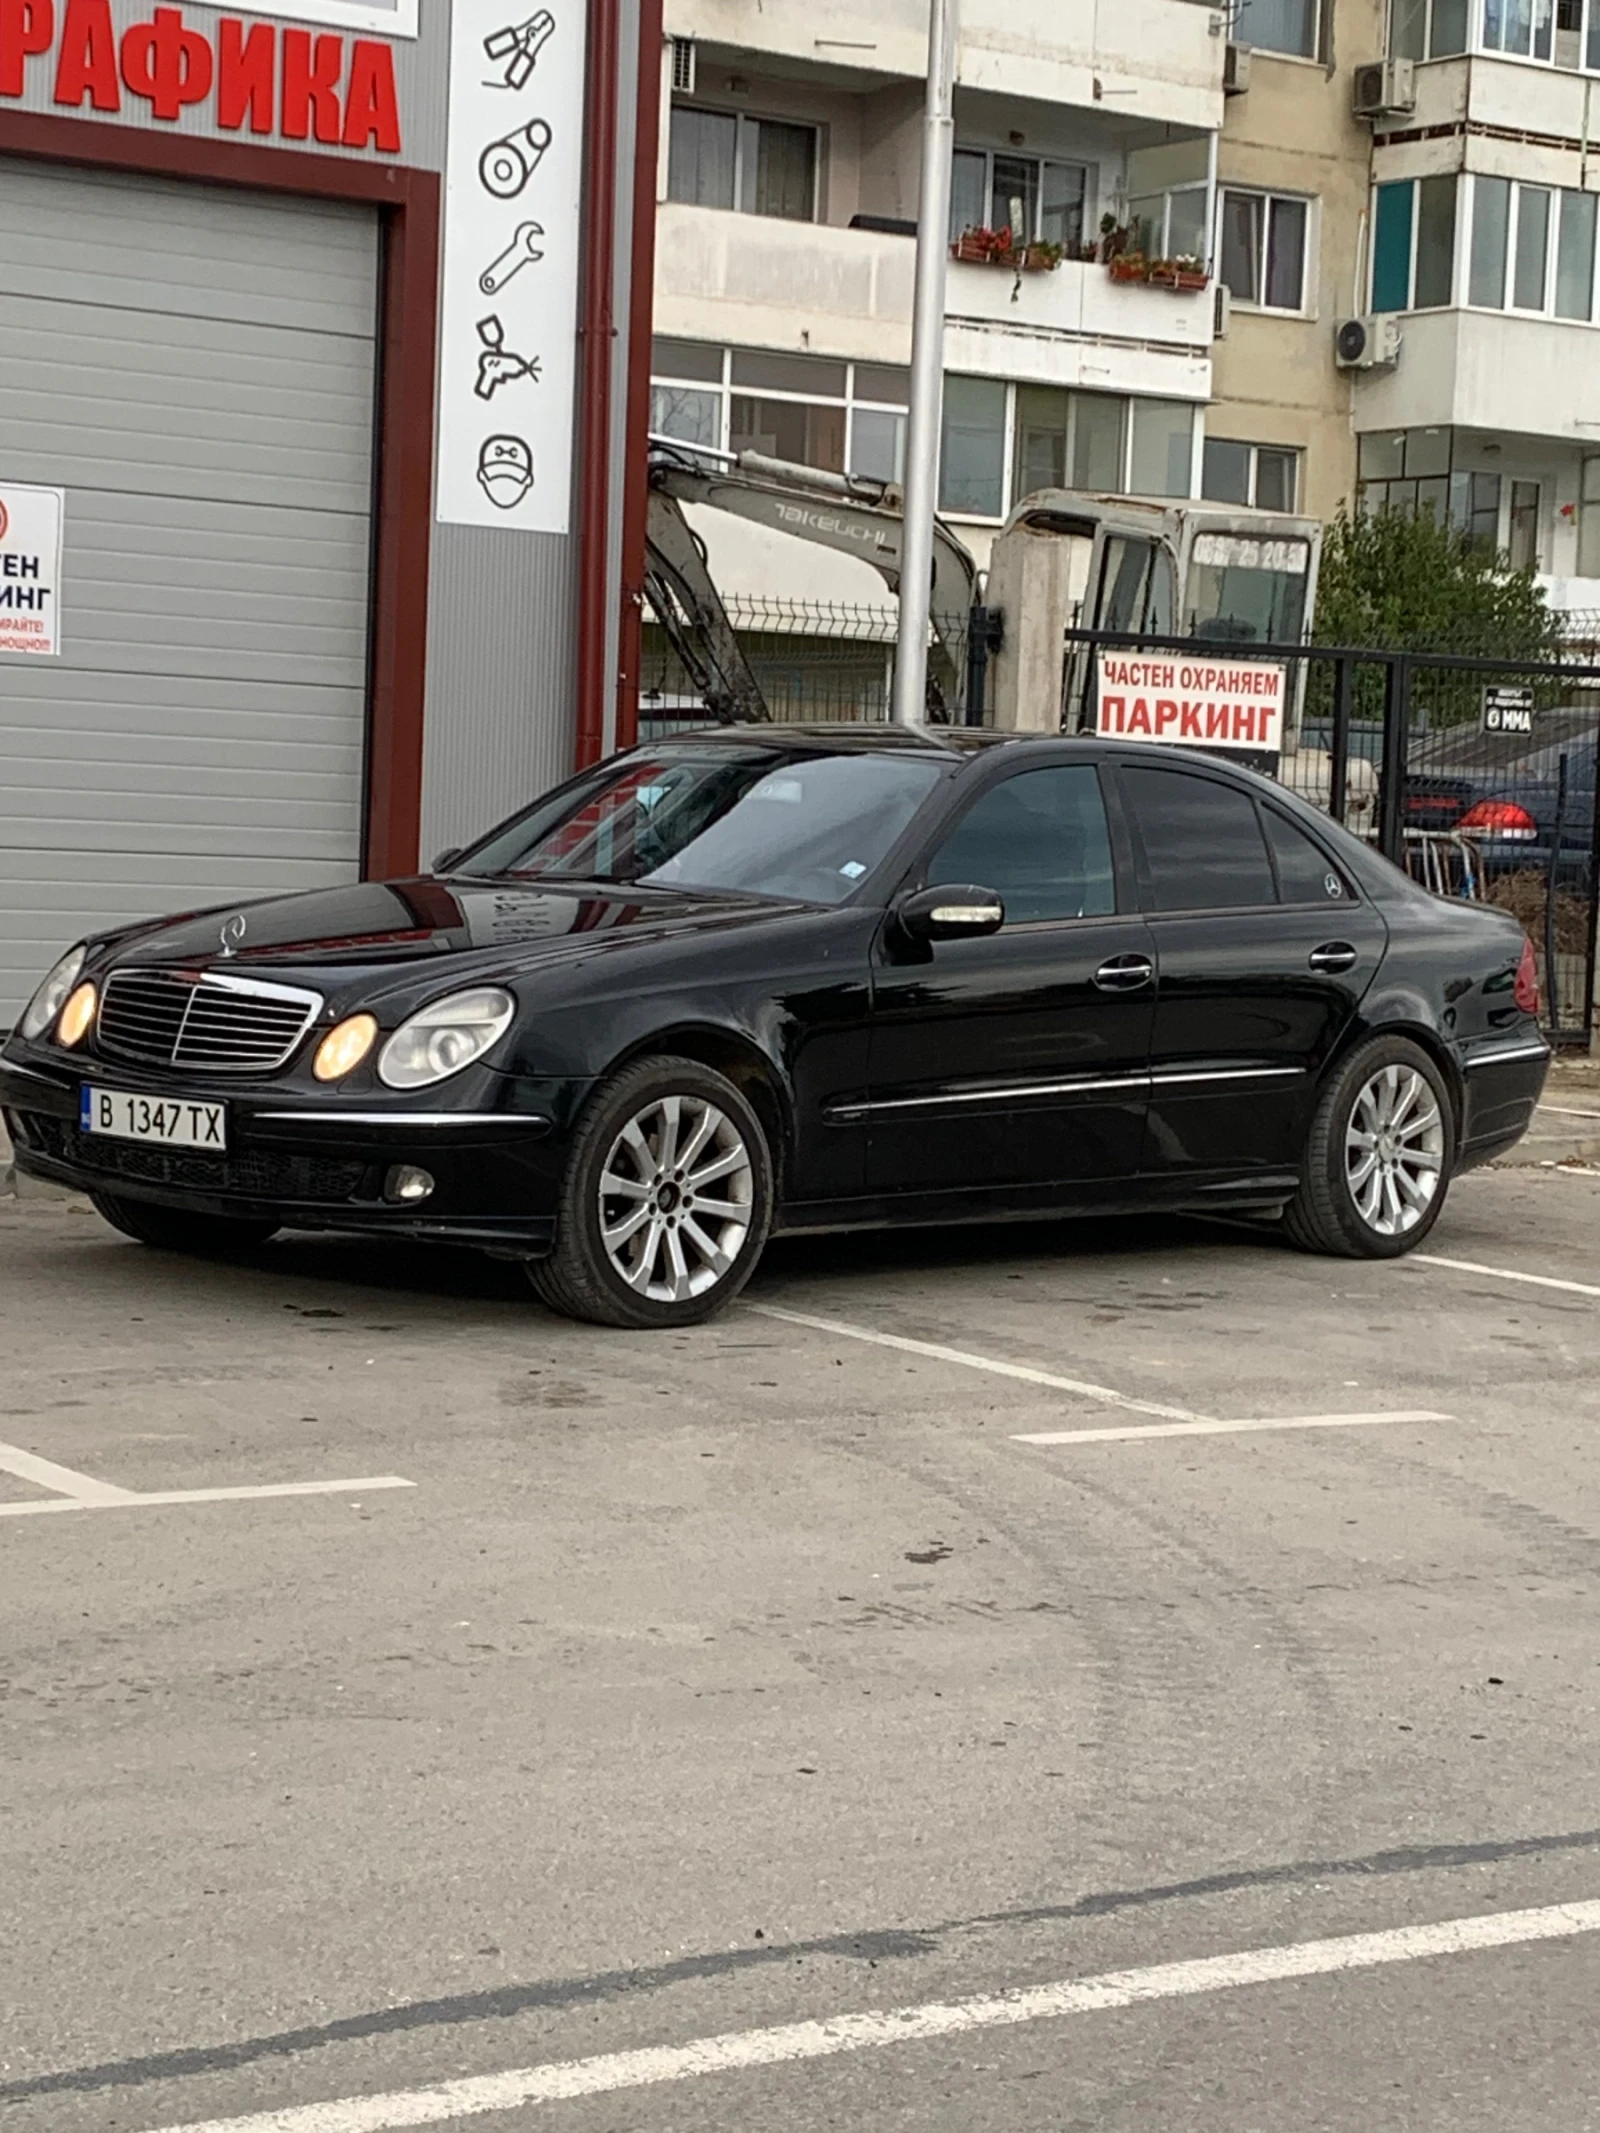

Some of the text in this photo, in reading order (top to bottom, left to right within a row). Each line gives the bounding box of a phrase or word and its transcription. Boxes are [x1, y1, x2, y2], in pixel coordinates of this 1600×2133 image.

[0, 0, 401, 153] РАФИКА
[0, 553, 39, 579] ЕН
[1104, 661, 1279, 697] ЧАСТЕН ОХРАНЯЕМ
[1101, 696, 1276, 741] ПАРКИНГ
[100, 1094, 220, 1143] B 1347 TX
